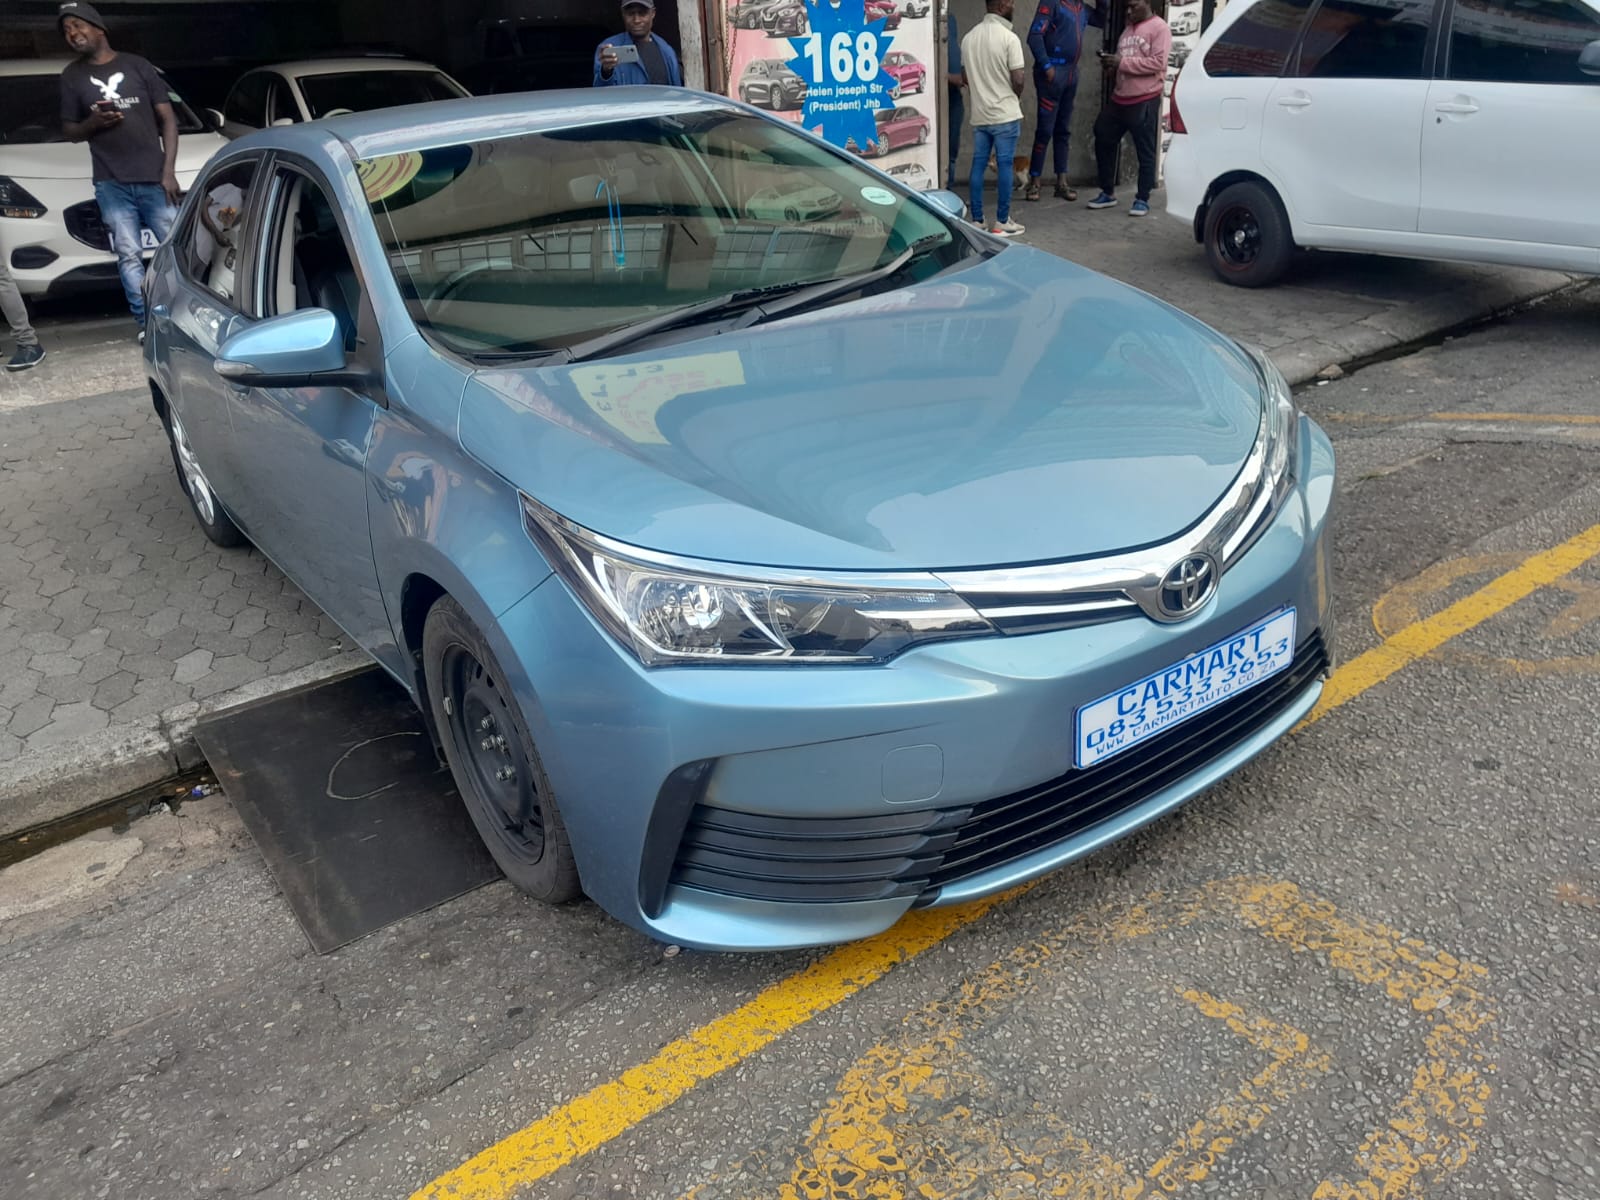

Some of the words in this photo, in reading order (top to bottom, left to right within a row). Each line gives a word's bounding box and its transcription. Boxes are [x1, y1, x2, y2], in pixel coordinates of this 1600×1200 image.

[804, 31, 879, 83] 168
[809, 100, 861, 115] (President)
[864, 98, 881, 109] Jhb
[836, 84, 867, 98] joseph
[870, 83, 883, 94] Str
[1086, 708, 1146, 749] 083
[1156, 676, 1212, 714] 533
[1222, 637, 1289, 683] 3653
[1117, 627, 1265, 716] CARMART
